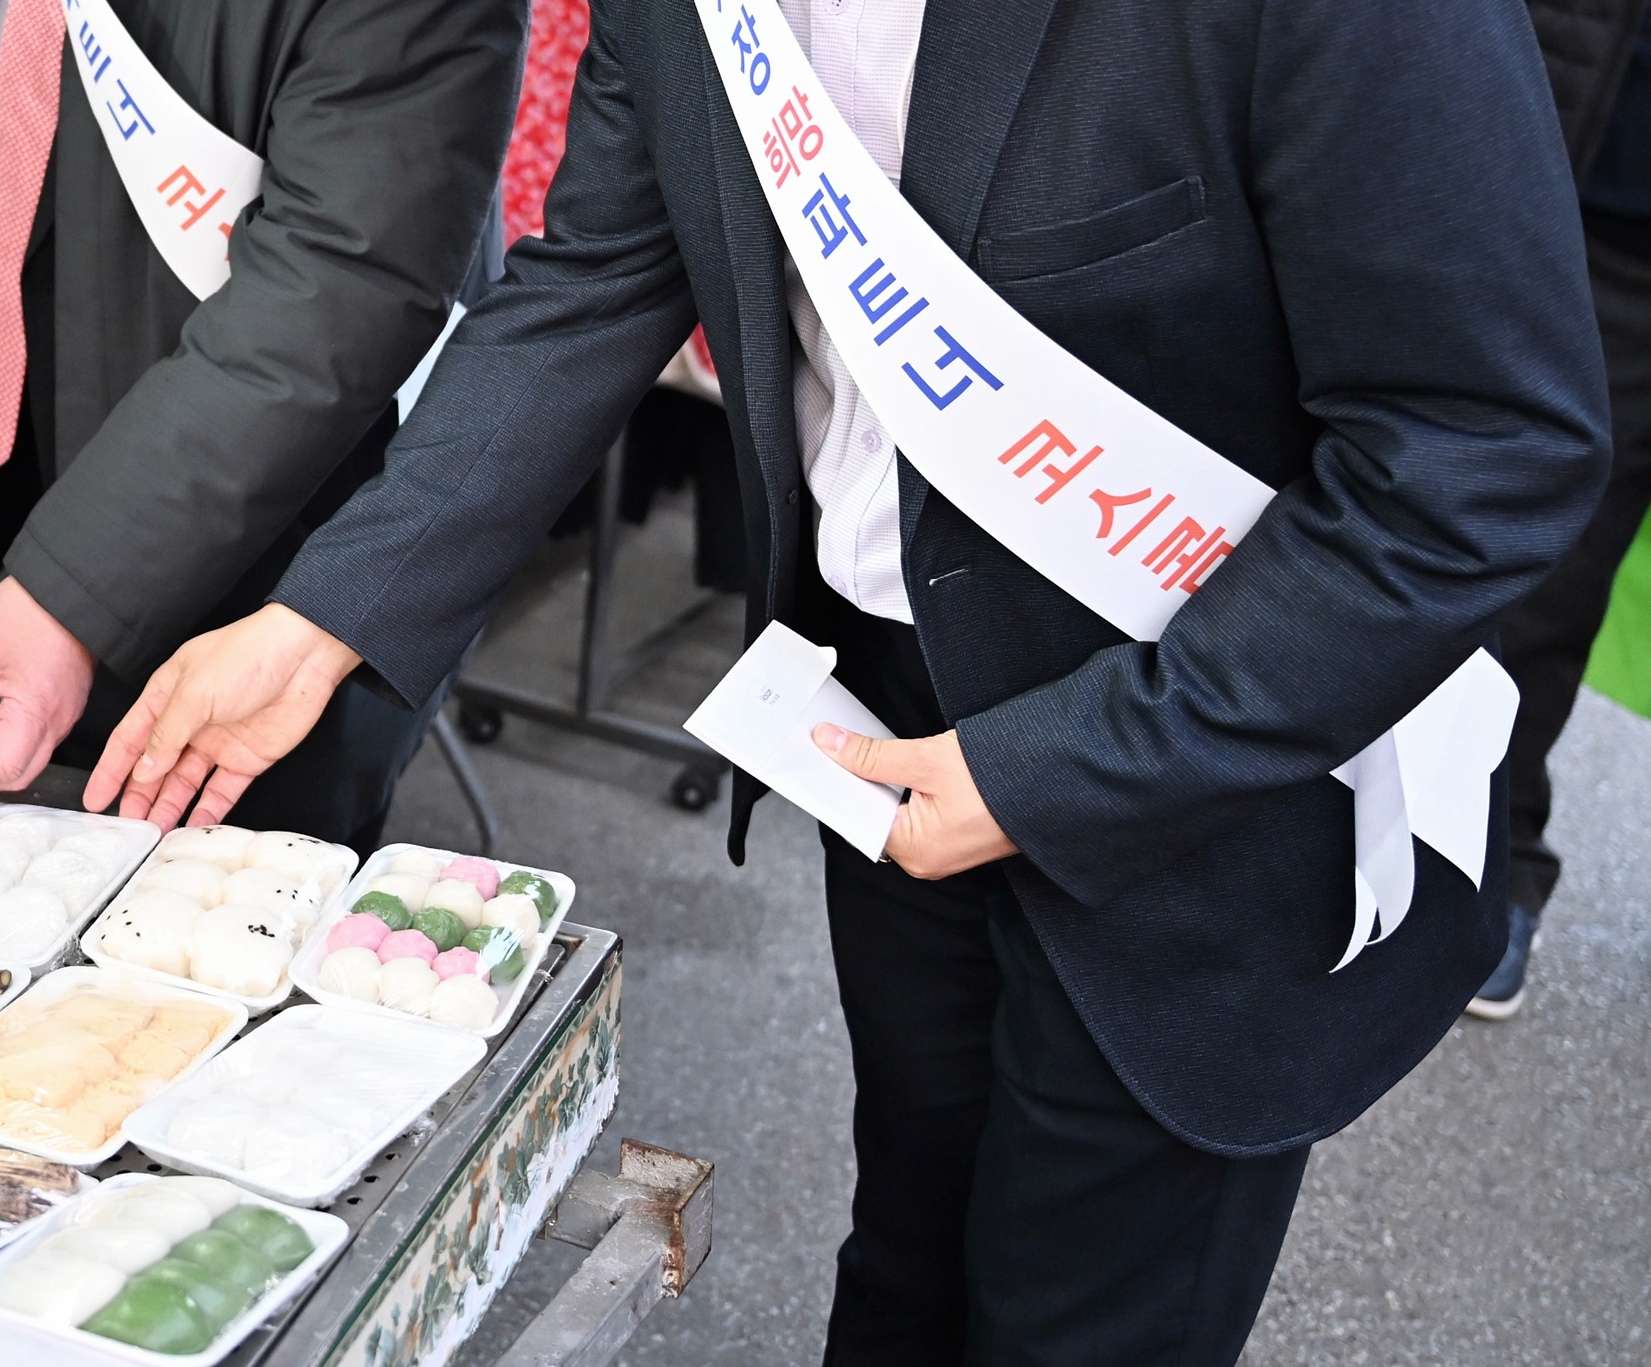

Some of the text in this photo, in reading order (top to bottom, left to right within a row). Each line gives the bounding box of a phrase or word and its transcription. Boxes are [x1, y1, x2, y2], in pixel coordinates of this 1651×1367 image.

[763, 86, 824, 189] 희망
[801, 172, 1005, 411] 파트너
[998, 419, 1236, 597] 코스콤
